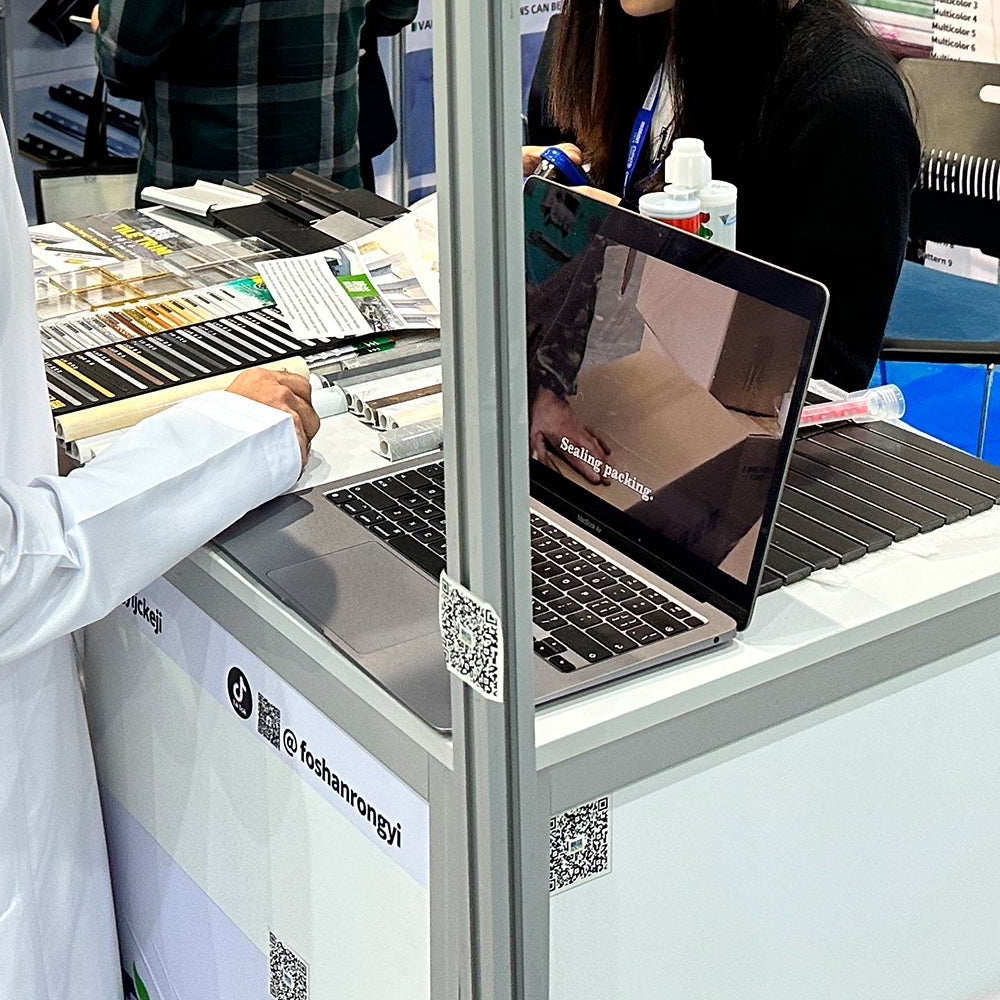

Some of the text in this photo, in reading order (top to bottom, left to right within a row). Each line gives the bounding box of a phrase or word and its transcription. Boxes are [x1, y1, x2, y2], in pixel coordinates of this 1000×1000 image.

[531, 3, 550, 14] CAN
[933, 8, 972, 22] Multicolor
[932, 21, 970, 36] Multicolor
[931, 36, 970, 50] Multicolor
[560, 436, 654, 502] Sealing packing.
[283, 728, 402, 848] @ foshanrongyi
